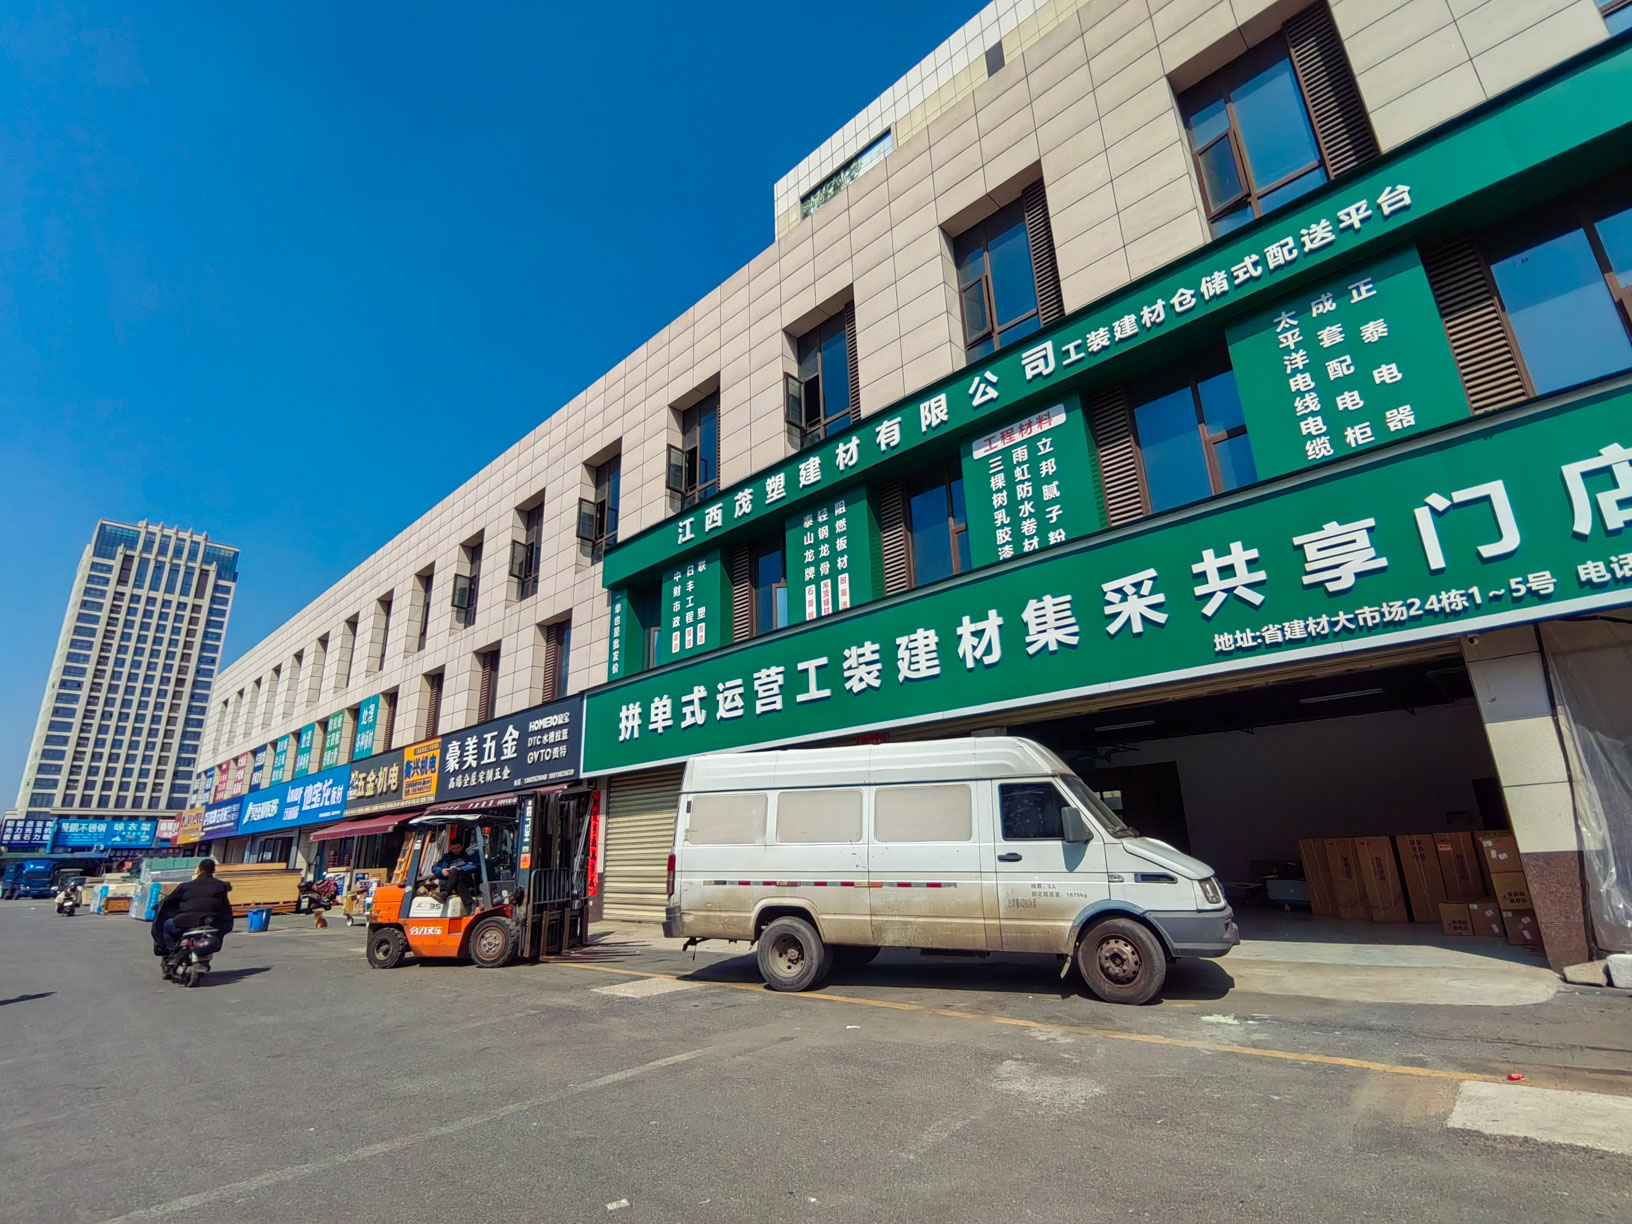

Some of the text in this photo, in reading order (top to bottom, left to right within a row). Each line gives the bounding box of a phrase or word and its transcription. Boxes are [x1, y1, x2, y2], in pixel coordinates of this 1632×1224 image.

[677, 183, 1412, 545] 江西茂塑建材有限公司 工装建材仓储式配送平台
[1273, 311, 1334, 462] 太平洋电线电缆
[1311, 292, 1375, 448] 成套配电柜
[1348, 278, 1416, 432] 正泰电器
[983, 411, 1053, 453] 工程材料
[834, 500, 848, 570] 阻燃板材
[988, 456, 1014, 560] 三棵树乳胶漆
[1012, 445, 1039, 552] 雨虹防水卷材
[1037, 438, 1066, 546] 立邦腻子粉
[803, 514, 816, 581] 泰山龙牌
[817, 508, 830, 576] 轻钢龙骨
[1577, 553, 1632, 583] 电话
[618, 442, 1632, 742] 拼单式运营工装建材集采共享门店
[685, 565, 694, 624] 日丰工程
[445, 725, 520, 773] 豪美五金
[410, 926, 443, 935] 合力叉车
